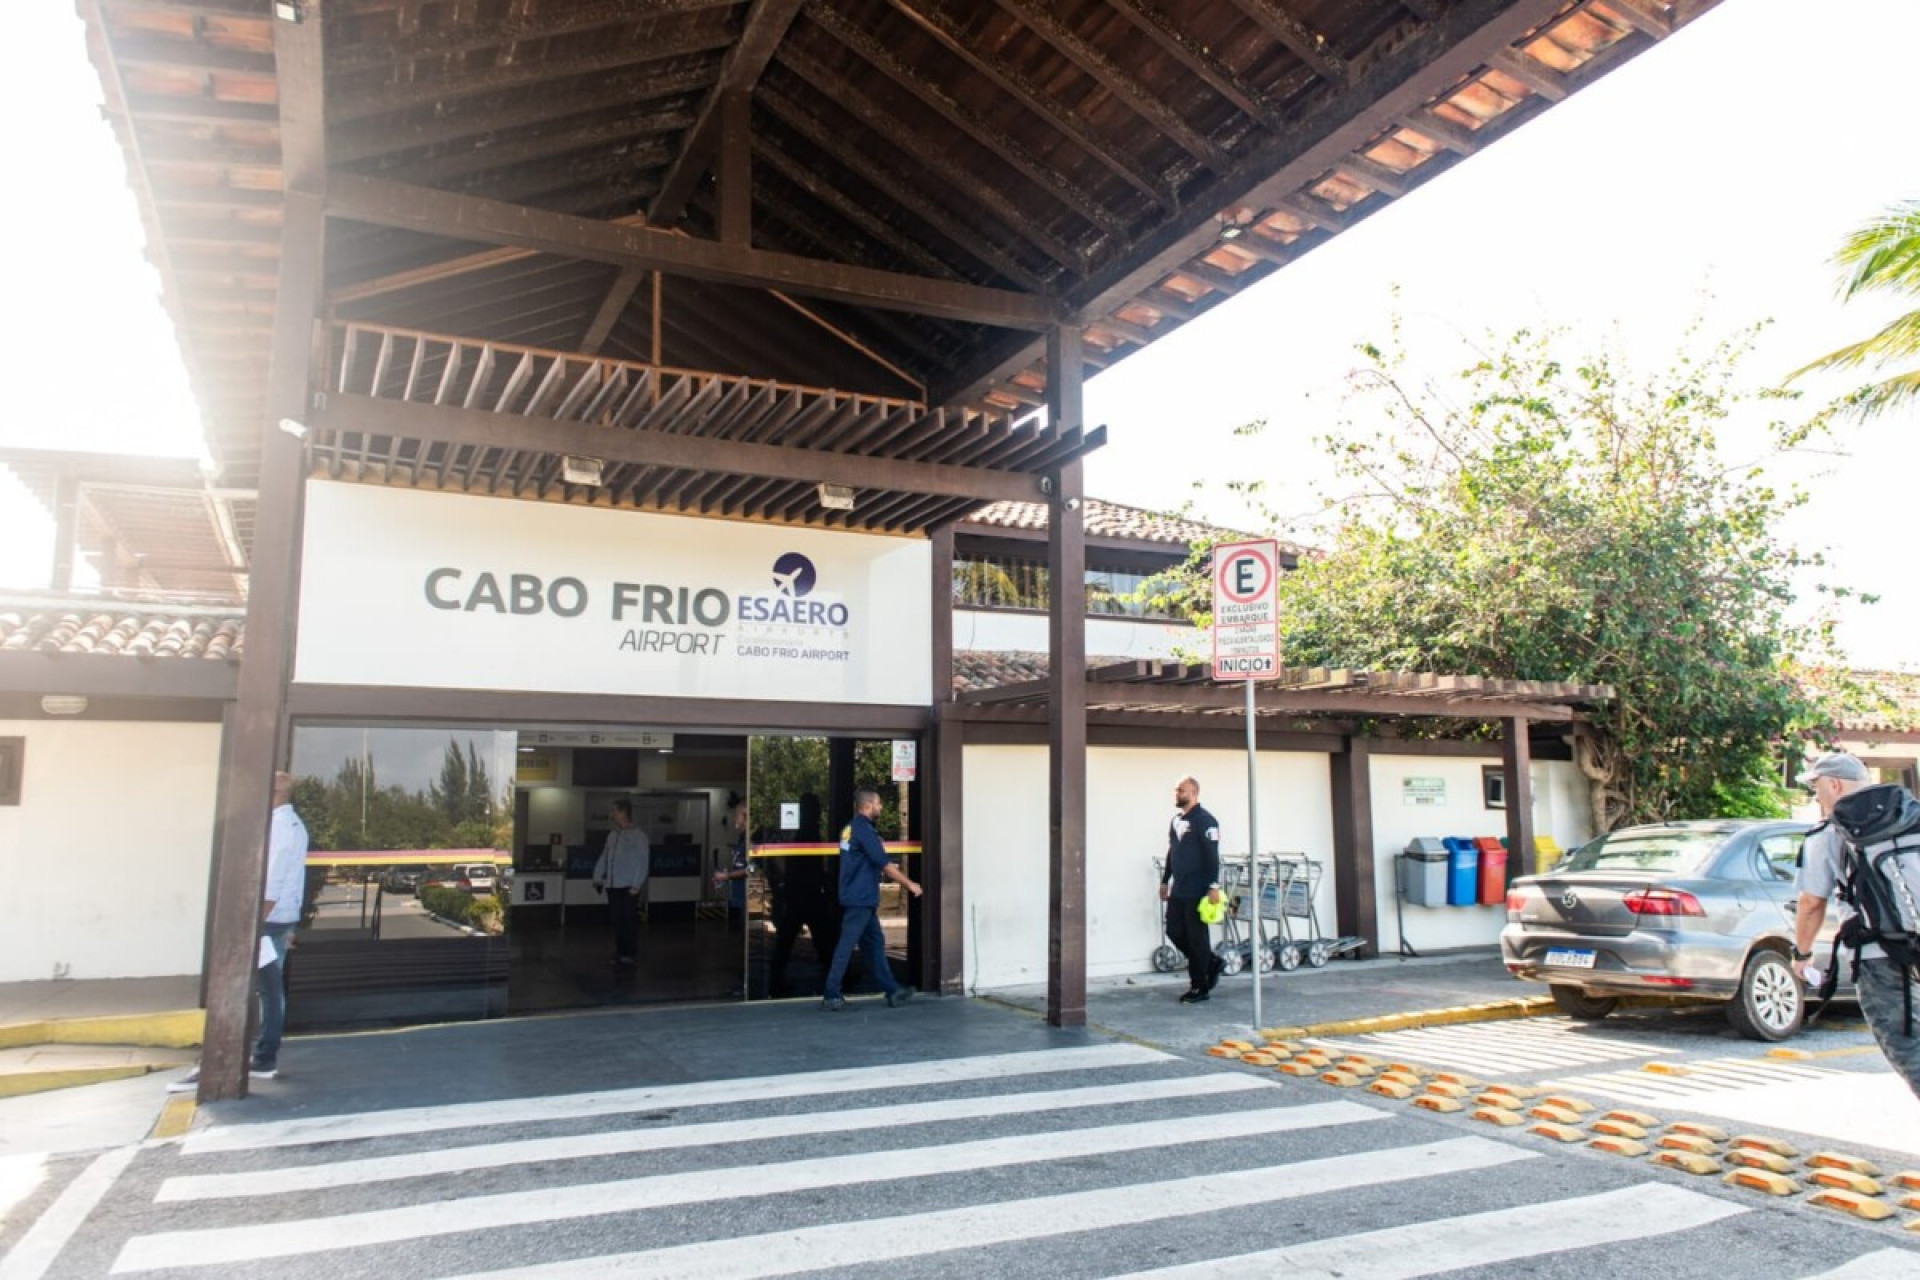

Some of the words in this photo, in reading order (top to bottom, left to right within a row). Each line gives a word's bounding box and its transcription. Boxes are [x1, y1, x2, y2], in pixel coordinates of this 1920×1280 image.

[1236, 558, 1255, 595] E
[424, 567, 589, 618] CABO
[611, 581, 731, 628] FRIO
[737, 595, 849, 627] ESAERO
[1220, 601, 1270, 614] EXCLUSIVO
[1220, 612, 1268, 625] EMBARQUE
[619, 628, 726, 655] AIRPORT
[737, 645, 770, 657] CABO
[772, 647, 799, 659] FRIO
[800, 648, 850, 661] AIRPORT
